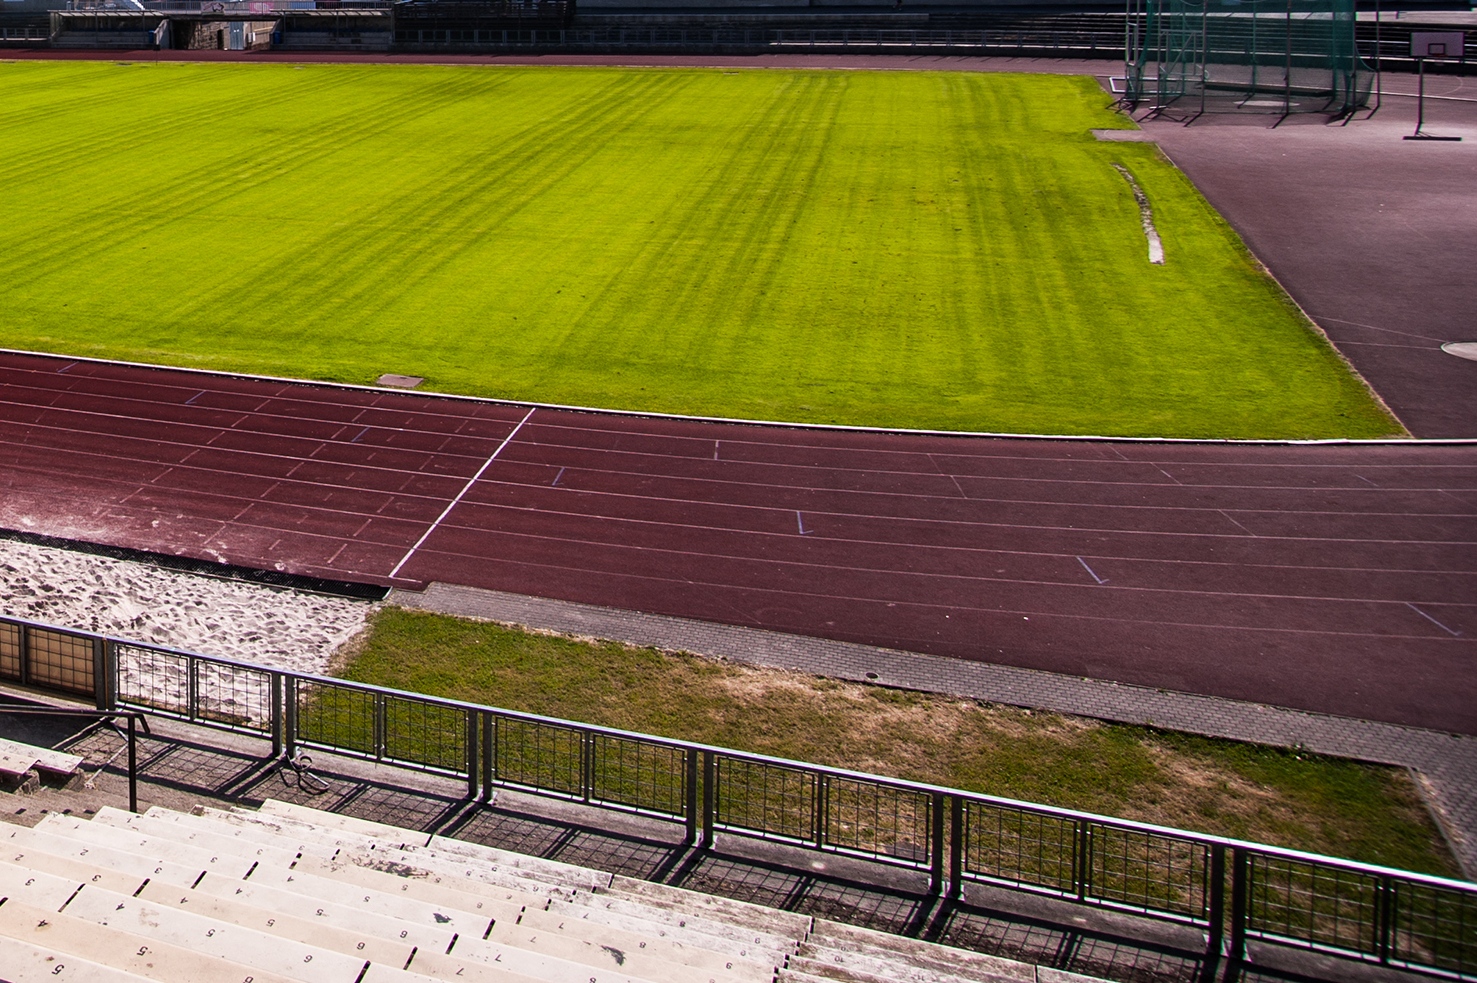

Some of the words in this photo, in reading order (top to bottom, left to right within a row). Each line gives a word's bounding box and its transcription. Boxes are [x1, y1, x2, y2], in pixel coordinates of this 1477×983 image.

[15, 854, 24, 862] 2
[154, 867, 163, 875] 3
[25, 878, 35, 886] 3
[180, 896, 189, 905] 4
[116, 903, 125, 911] 4
[315, 908, 324, 916] 5
[38, 919, 48, 928] 4
[266, 919, 275, 927] 5
[206, 928, 216, 938] 5
[400, 930, 408, 939] 6
[356, 942, 366, 950] 6
[137, 946, 149, 956] 5
[304, 955, 313, 963] 6
[51, 964, 64, 975] 5
[456, 968, 465, 976] 7
